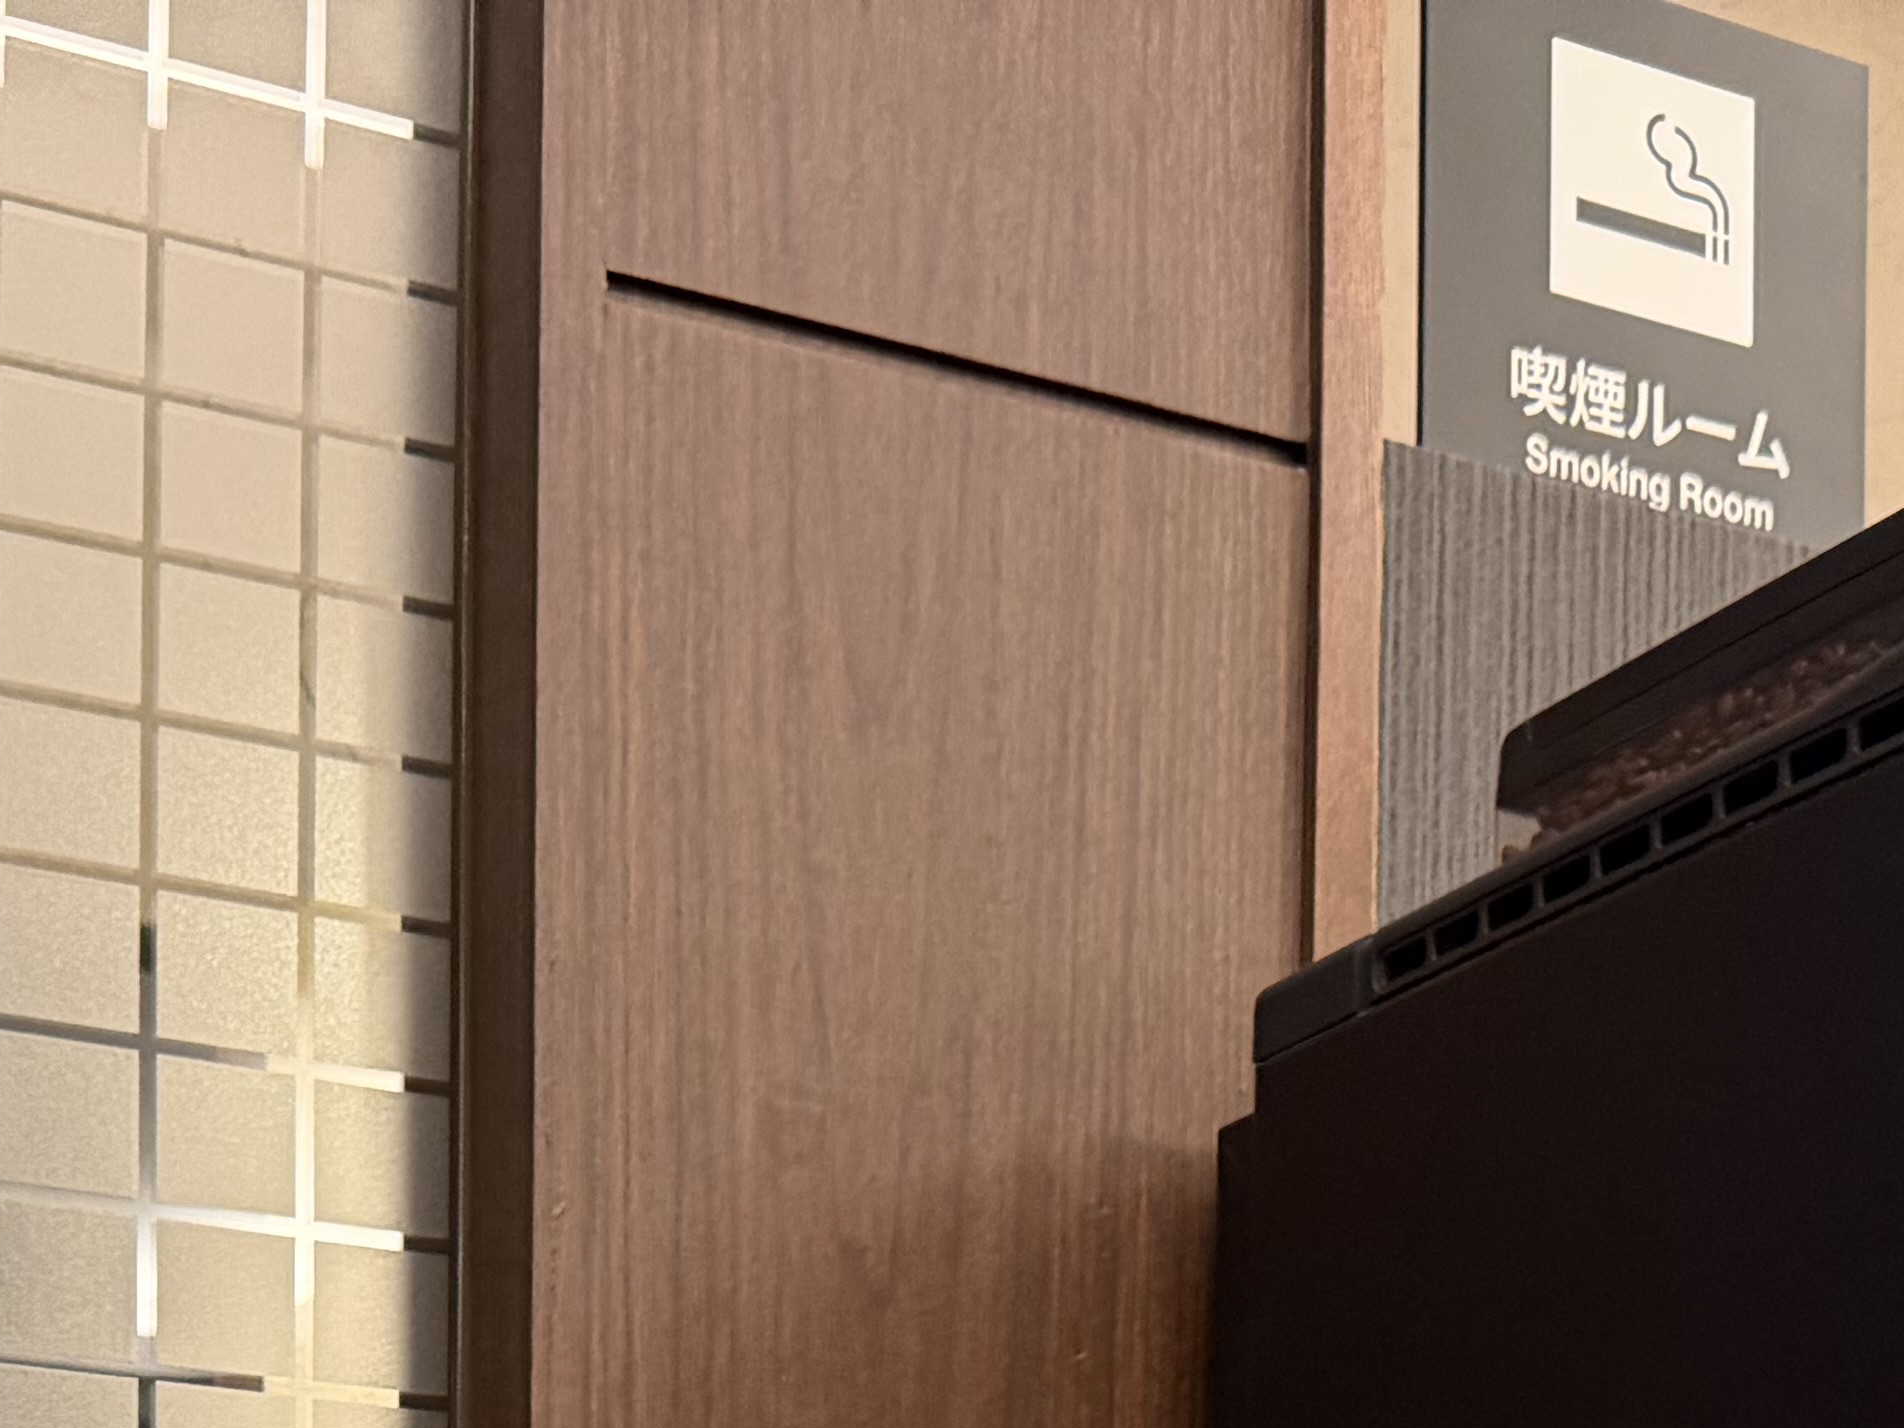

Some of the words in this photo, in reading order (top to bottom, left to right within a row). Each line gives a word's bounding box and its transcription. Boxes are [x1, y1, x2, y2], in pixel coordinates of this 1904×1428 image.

[1509, 345, 1791, 479] 喫煙ルーム
[1525, 433, 1670, 512] Smoking
[1679, 472, 1774, 532] Room
